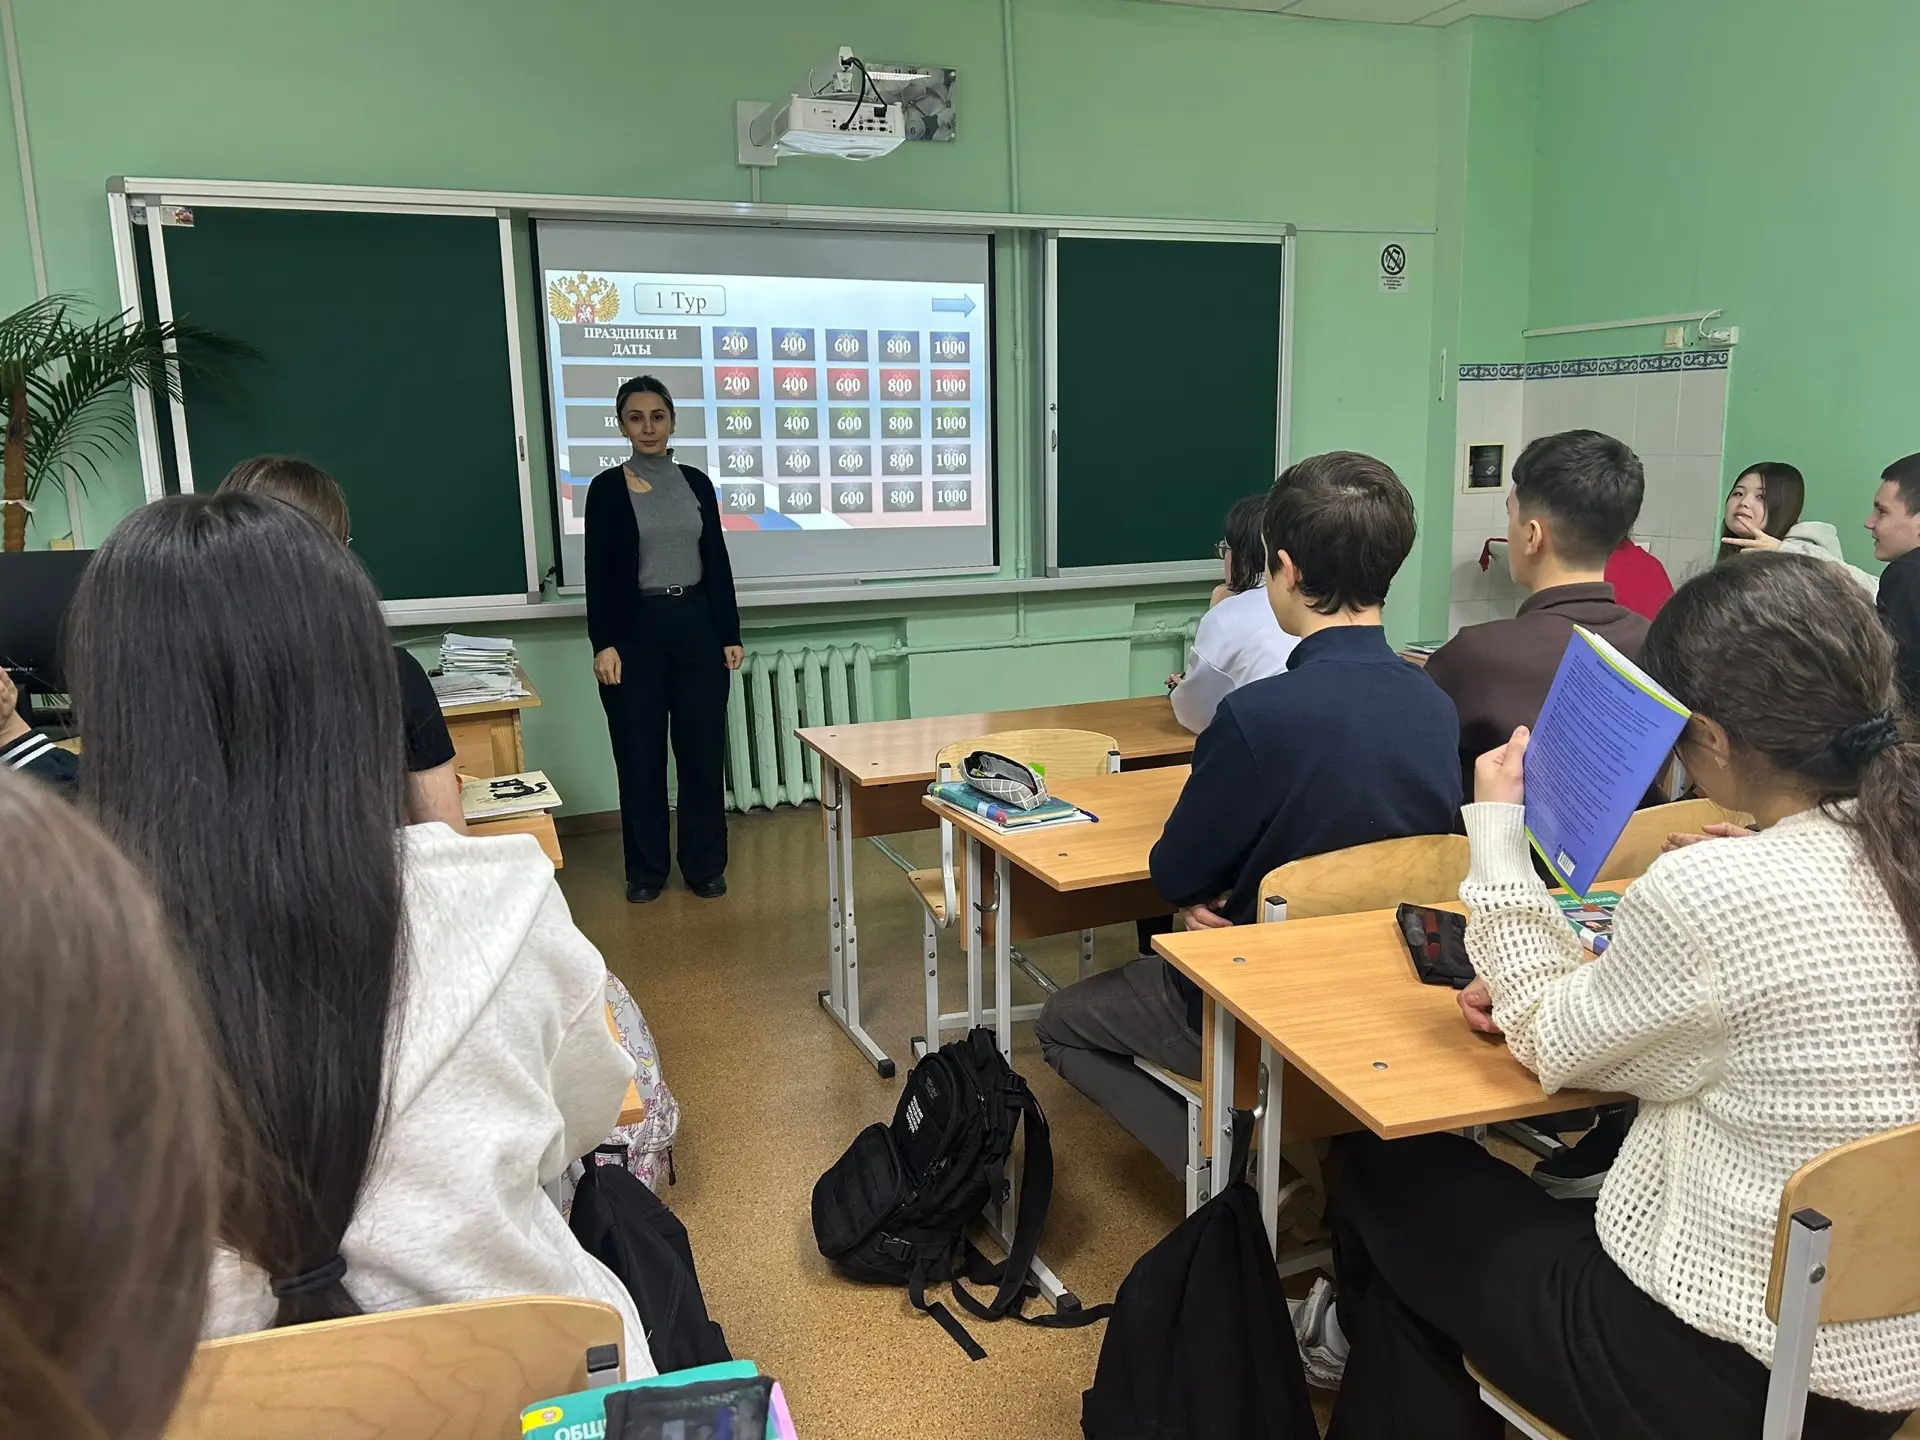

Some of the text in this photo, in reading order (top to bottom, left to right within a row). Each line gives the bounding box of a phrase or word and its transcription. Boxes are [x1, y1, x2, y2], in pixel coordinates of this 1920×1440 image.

[657, 292, 706, 313] 1 Тур
[584, 328, 677, 340] ПРАЗДНИКИ И
[612, 344, 651, 356] ДАТЫ
[722, 336, 965, 354] 200 400 600 800 1000
[724, 376, 966, 392] 200 400 600 800 1000
[726, 416, 966, 430] 200 400 600 800 1000
[728, 453, 967, 468] 200 400 600 800 1000
[730, 490, 967, 506] 200 400 600 800 1000
